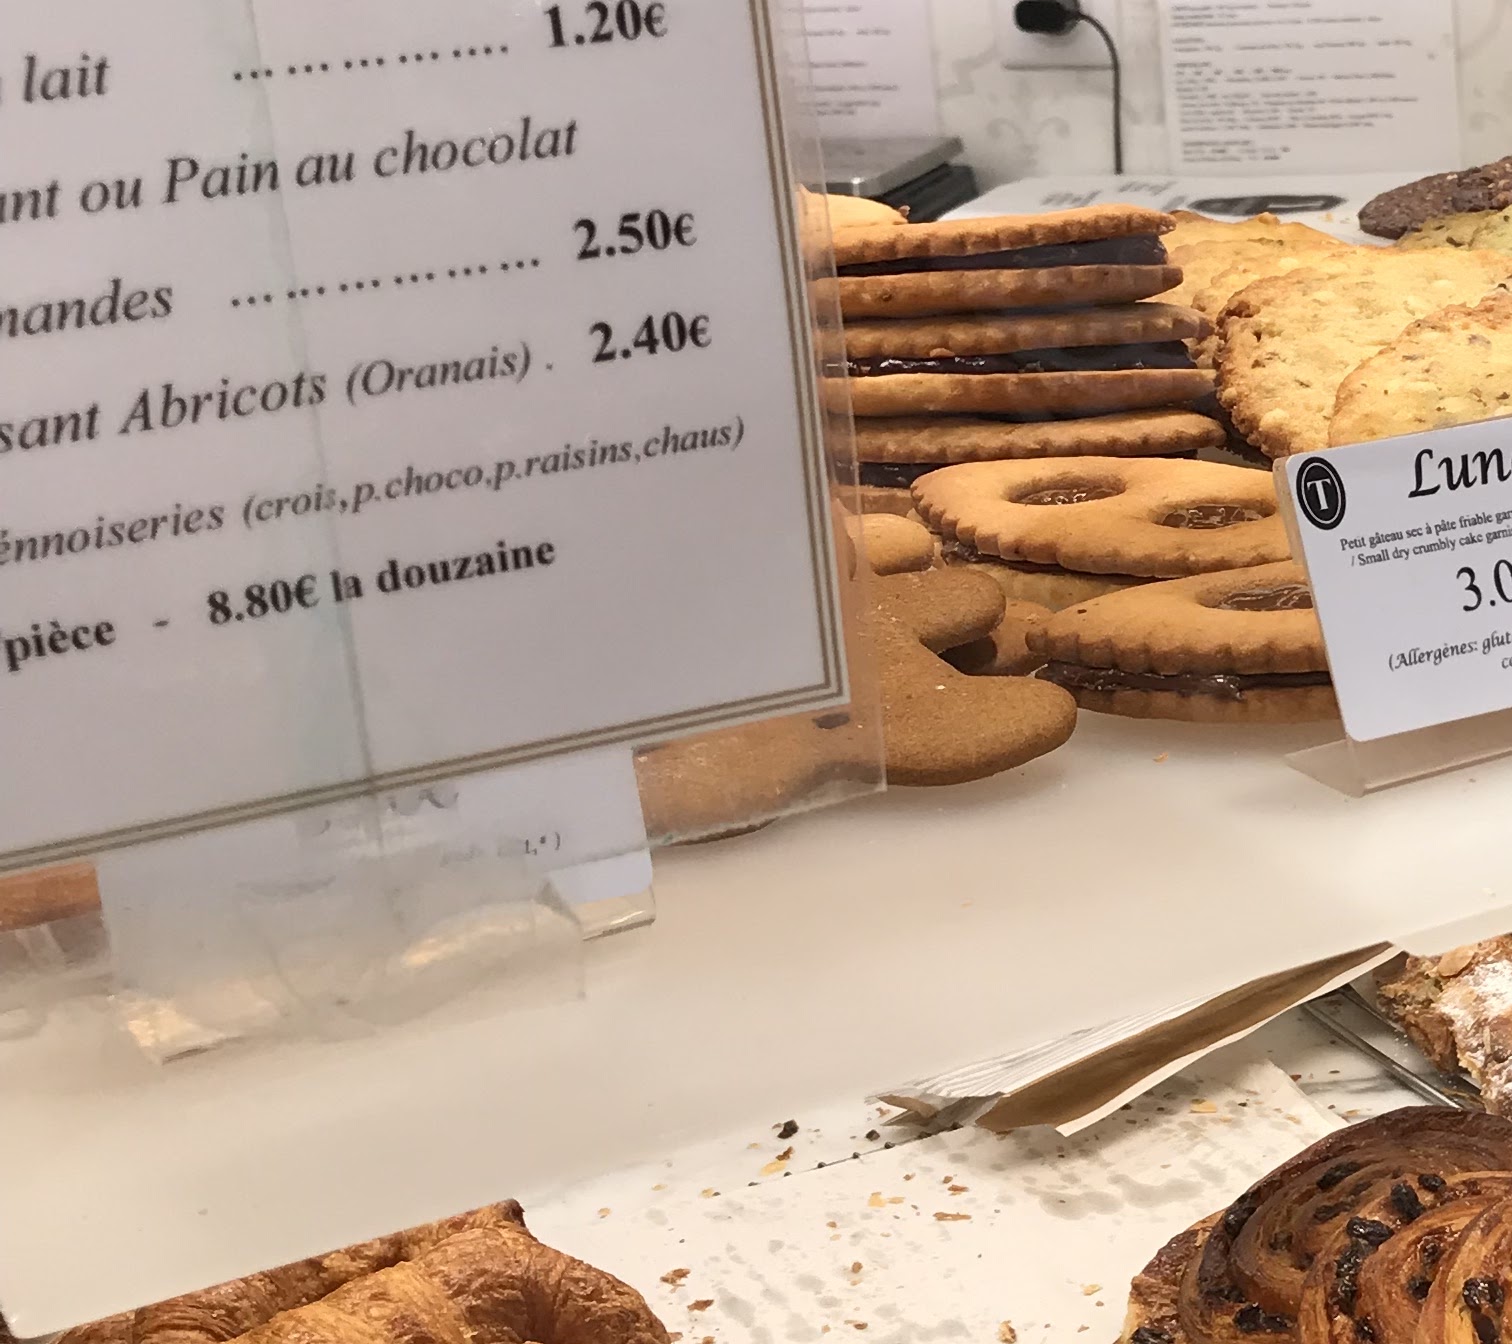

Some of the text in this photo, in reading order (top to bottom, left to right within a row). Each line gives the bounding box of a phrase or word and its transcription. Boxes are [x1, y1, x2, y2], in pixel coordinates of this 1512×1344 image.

[24, 0, 663, 103] lait 1.20€
[81, 179, 141, 212] ou
[164, 153, 279, 203] Pain
[296, 153, 354, 187] au
[374, 114, 577, 177] chocolat
[575, 209, 693, 260] 2.50€
[0, 312, 708, 453] sant Abricots (Oranais) 2.40€
[2, 541, 554, 672] pièce 8.80€ la douzaine
